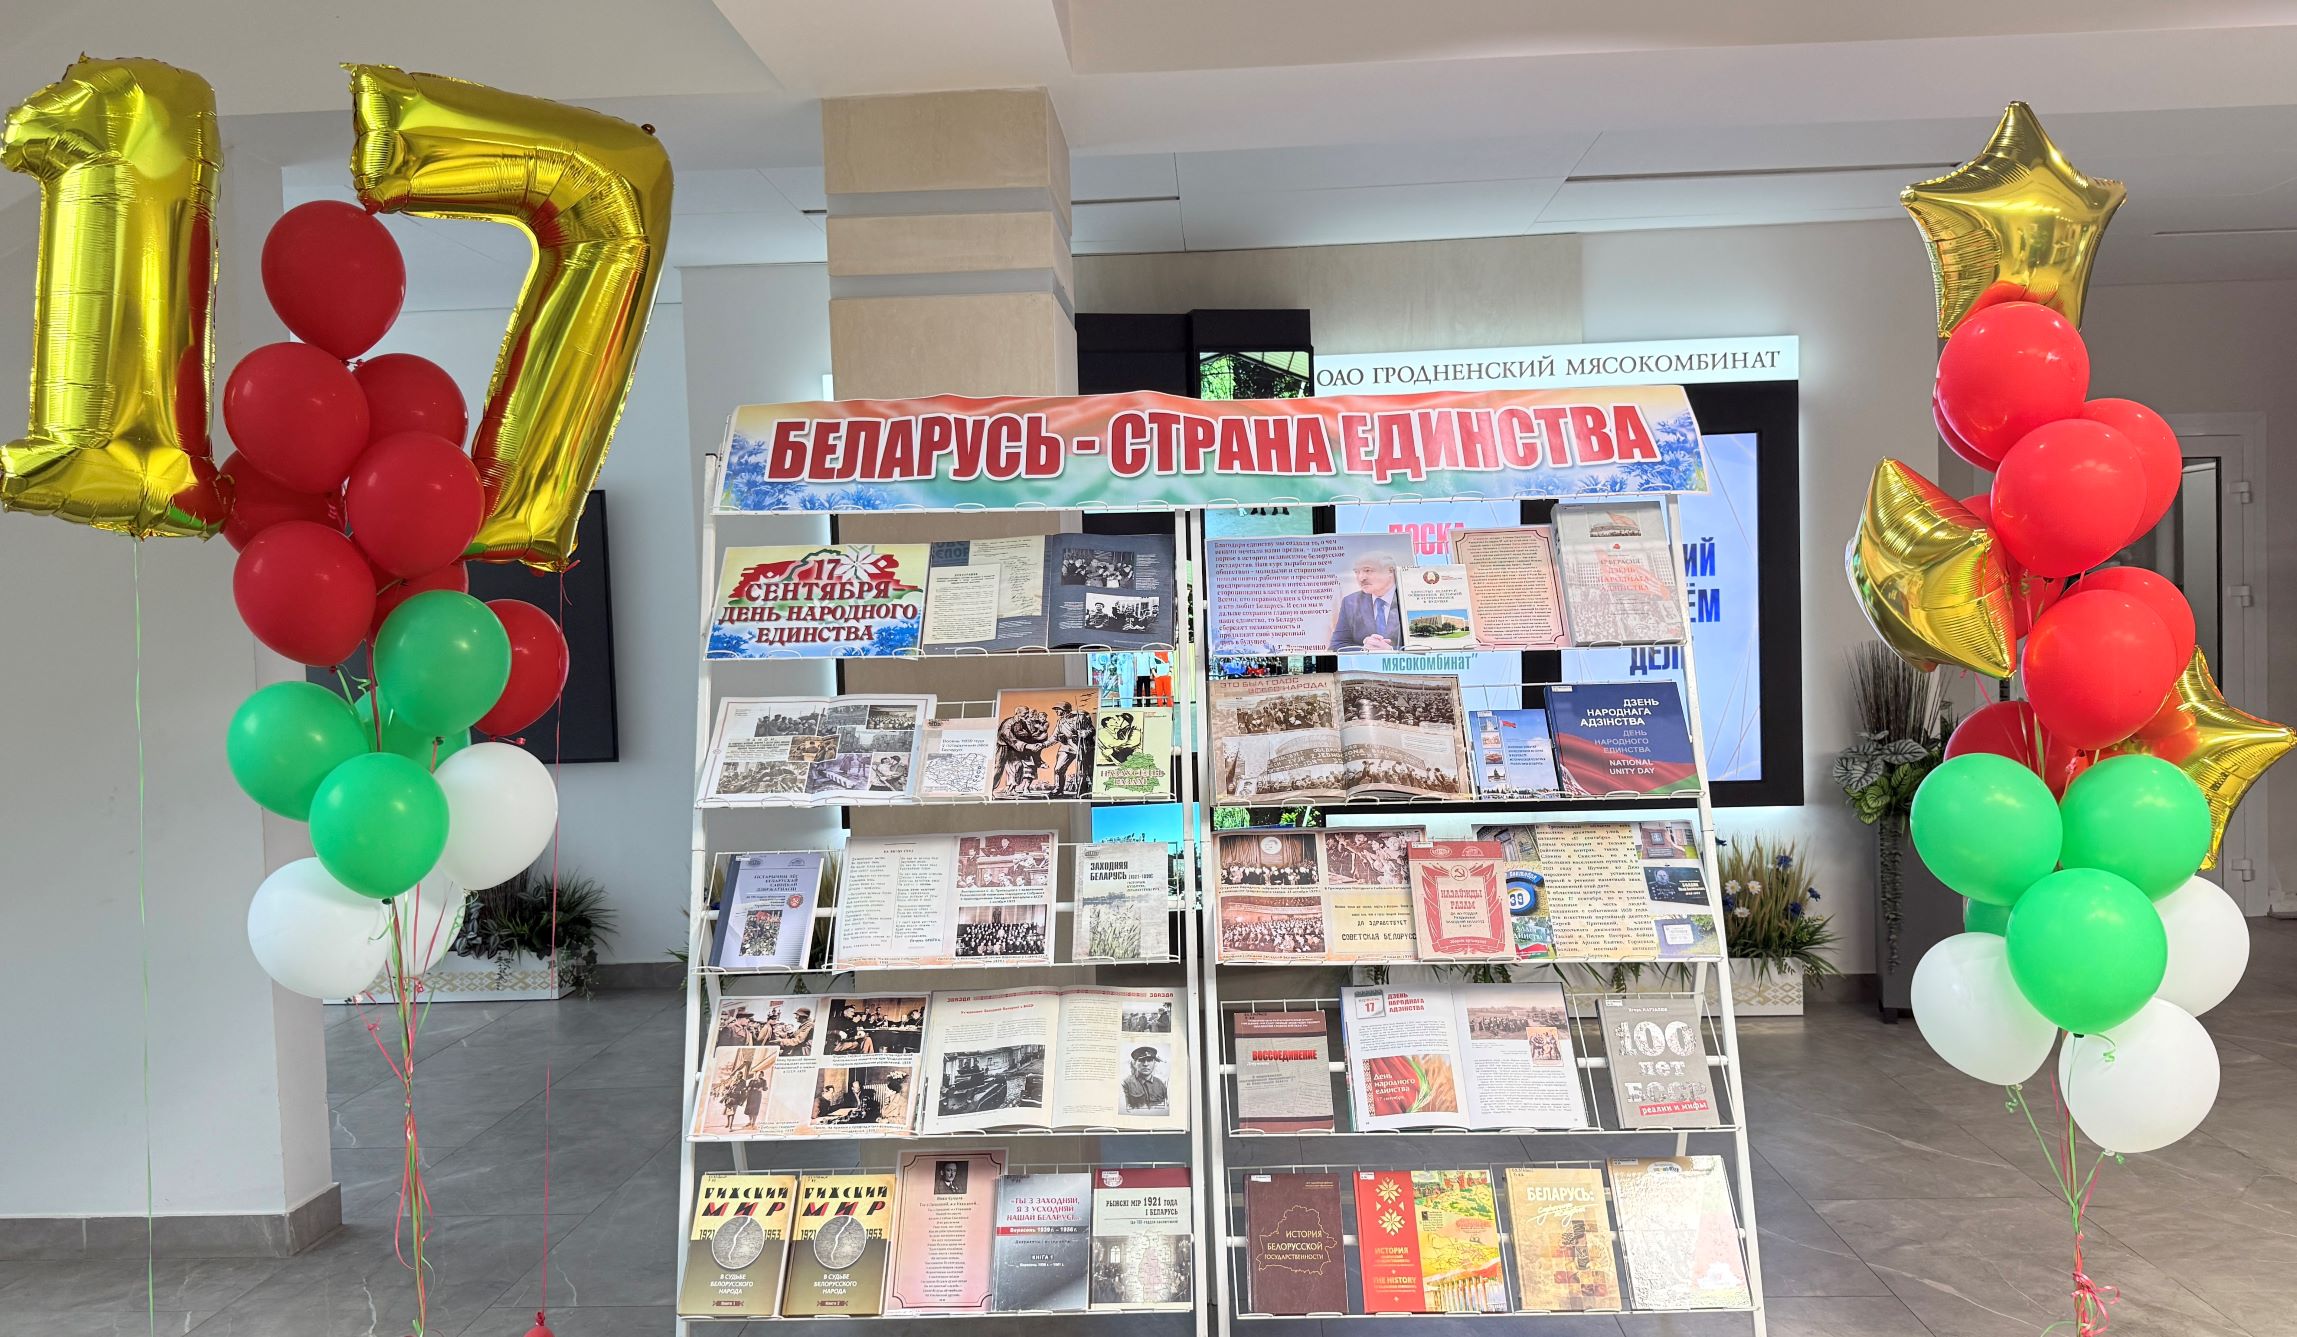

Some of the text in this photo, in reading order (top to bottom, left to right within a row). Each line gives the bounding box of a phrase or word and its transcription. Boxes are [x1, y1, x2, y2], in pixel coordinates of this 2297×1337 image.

[1316, 350, 1780, 387] ОАО ГРОДНЕНСКИЙ МЯСОКОМБИНАТ
[766, 413, 1065, 481] БЕЛАРУСЬ
[1110, 411, 1333, 477] СТРАНА
[1343, 405, 1659, 484] ЕДИНСТВА
[814, 558, 841, 580] 17
[745, 580, 892, 602] СЕНТЯБРЯ
[718, 603, 918, 625] ДЕНЬ НАРОДНОГО
[755, 624, 874, 646] ЕДИНСТВА
[1623, 699, 1659, 708] ДЗЕНЬ
[1587, 708, 1652, 717] НАРОДНАГА
[1580, 717, 1645, 727] АДЗІНСТВА
[1594, 738, 1649, 746] НАРОДНОГО
[1609, 759, 1653, 767] NATIONAL
[1091, 861, 1128, 871] ЗАХОДНЯЯ
[1090, 871, 1127, 880] БЕЛАРУСЬ
[1341, 933, 1380, 942] СОВЕТСКАЯ
[1365, 1002, 1375, 1012] 17
[1615, 1021, 1697, 1057] 100
[1252, 1049, 1318, 1062] ВОССОЕДИНЕНИЕ
[1374, 1079, 1416, 1088] народного
[1376, 1087, 1410, 1095] единства
[1642, 1106, 1672, 1114] реалии
[1682, 1102, 1707, 1110] мифы
[704, 1187, 788, 1199] РИЖСКИЙ
[804, 1186, 887, 1199] РИЖСКИЙ
[1527, 1186, 1595, 1201] БЕЛАРУСЬ:
[1144, 1197, 1161, 1206] 1921
[1163, 1199, 1178, 1207] ГОДА
[702, 1202, 785, 1216] МИР
[802, 1201, 885, 1216] МИР
[700, 1229, 781, 1240] 1921 1953
[801, 1228, 883, 1240] 1921 1953
[1286, 1230, 1322, 1238] ИСТОРИЯ
[1267, 1241, 1323, 1251] БЕЛОРУССКОЙ
[725, 1273, 747, 1281] СУДЬБЕ
[828, 1273, 850, 1281] СУДЬБЕ
